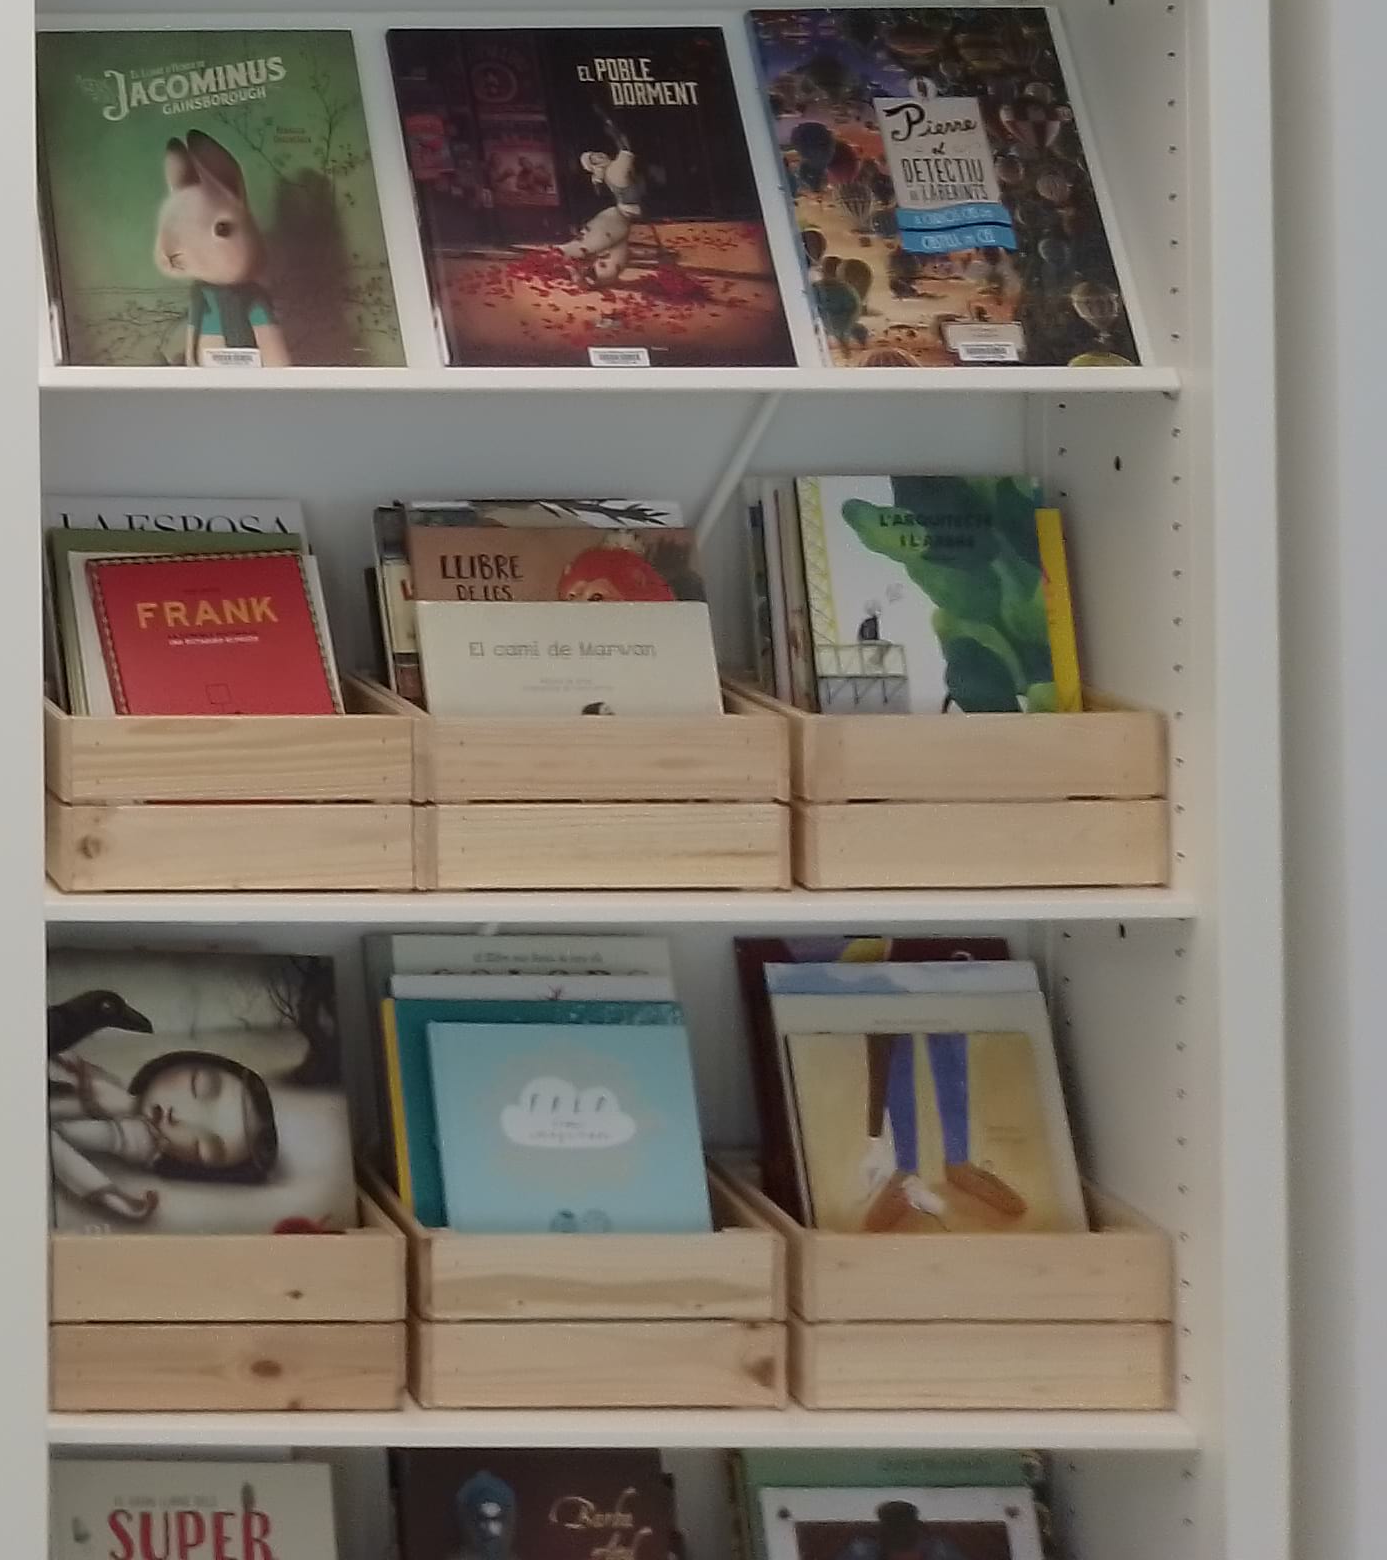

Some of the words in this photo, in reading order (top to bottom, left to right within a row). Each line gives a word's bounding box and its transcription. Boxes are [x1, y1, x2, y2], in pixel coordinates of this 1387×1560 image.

[577, 65, 595, 82] EL
[594, 58, 655, 81] POBLE
[102, 56, 287, 121] JACOMINUS
[162, 87, 266, 115] GAINSBOROUGH
[609, 82, 700, 106] DORMENT
[901, 158, 985, 183] DETECTIU
[440, 554, 524, 580] LLIBRE
[457, 584, 475, 601] DE
[483, 585, 514, 601] LES
[136, 596, 279, 629] FRANK
[469, 642, 484, 657] El
[548, 642, 572, 657] de
[579, 642, 657, 658] Marwan
[108, 1509, 280, 1560] SUPER
